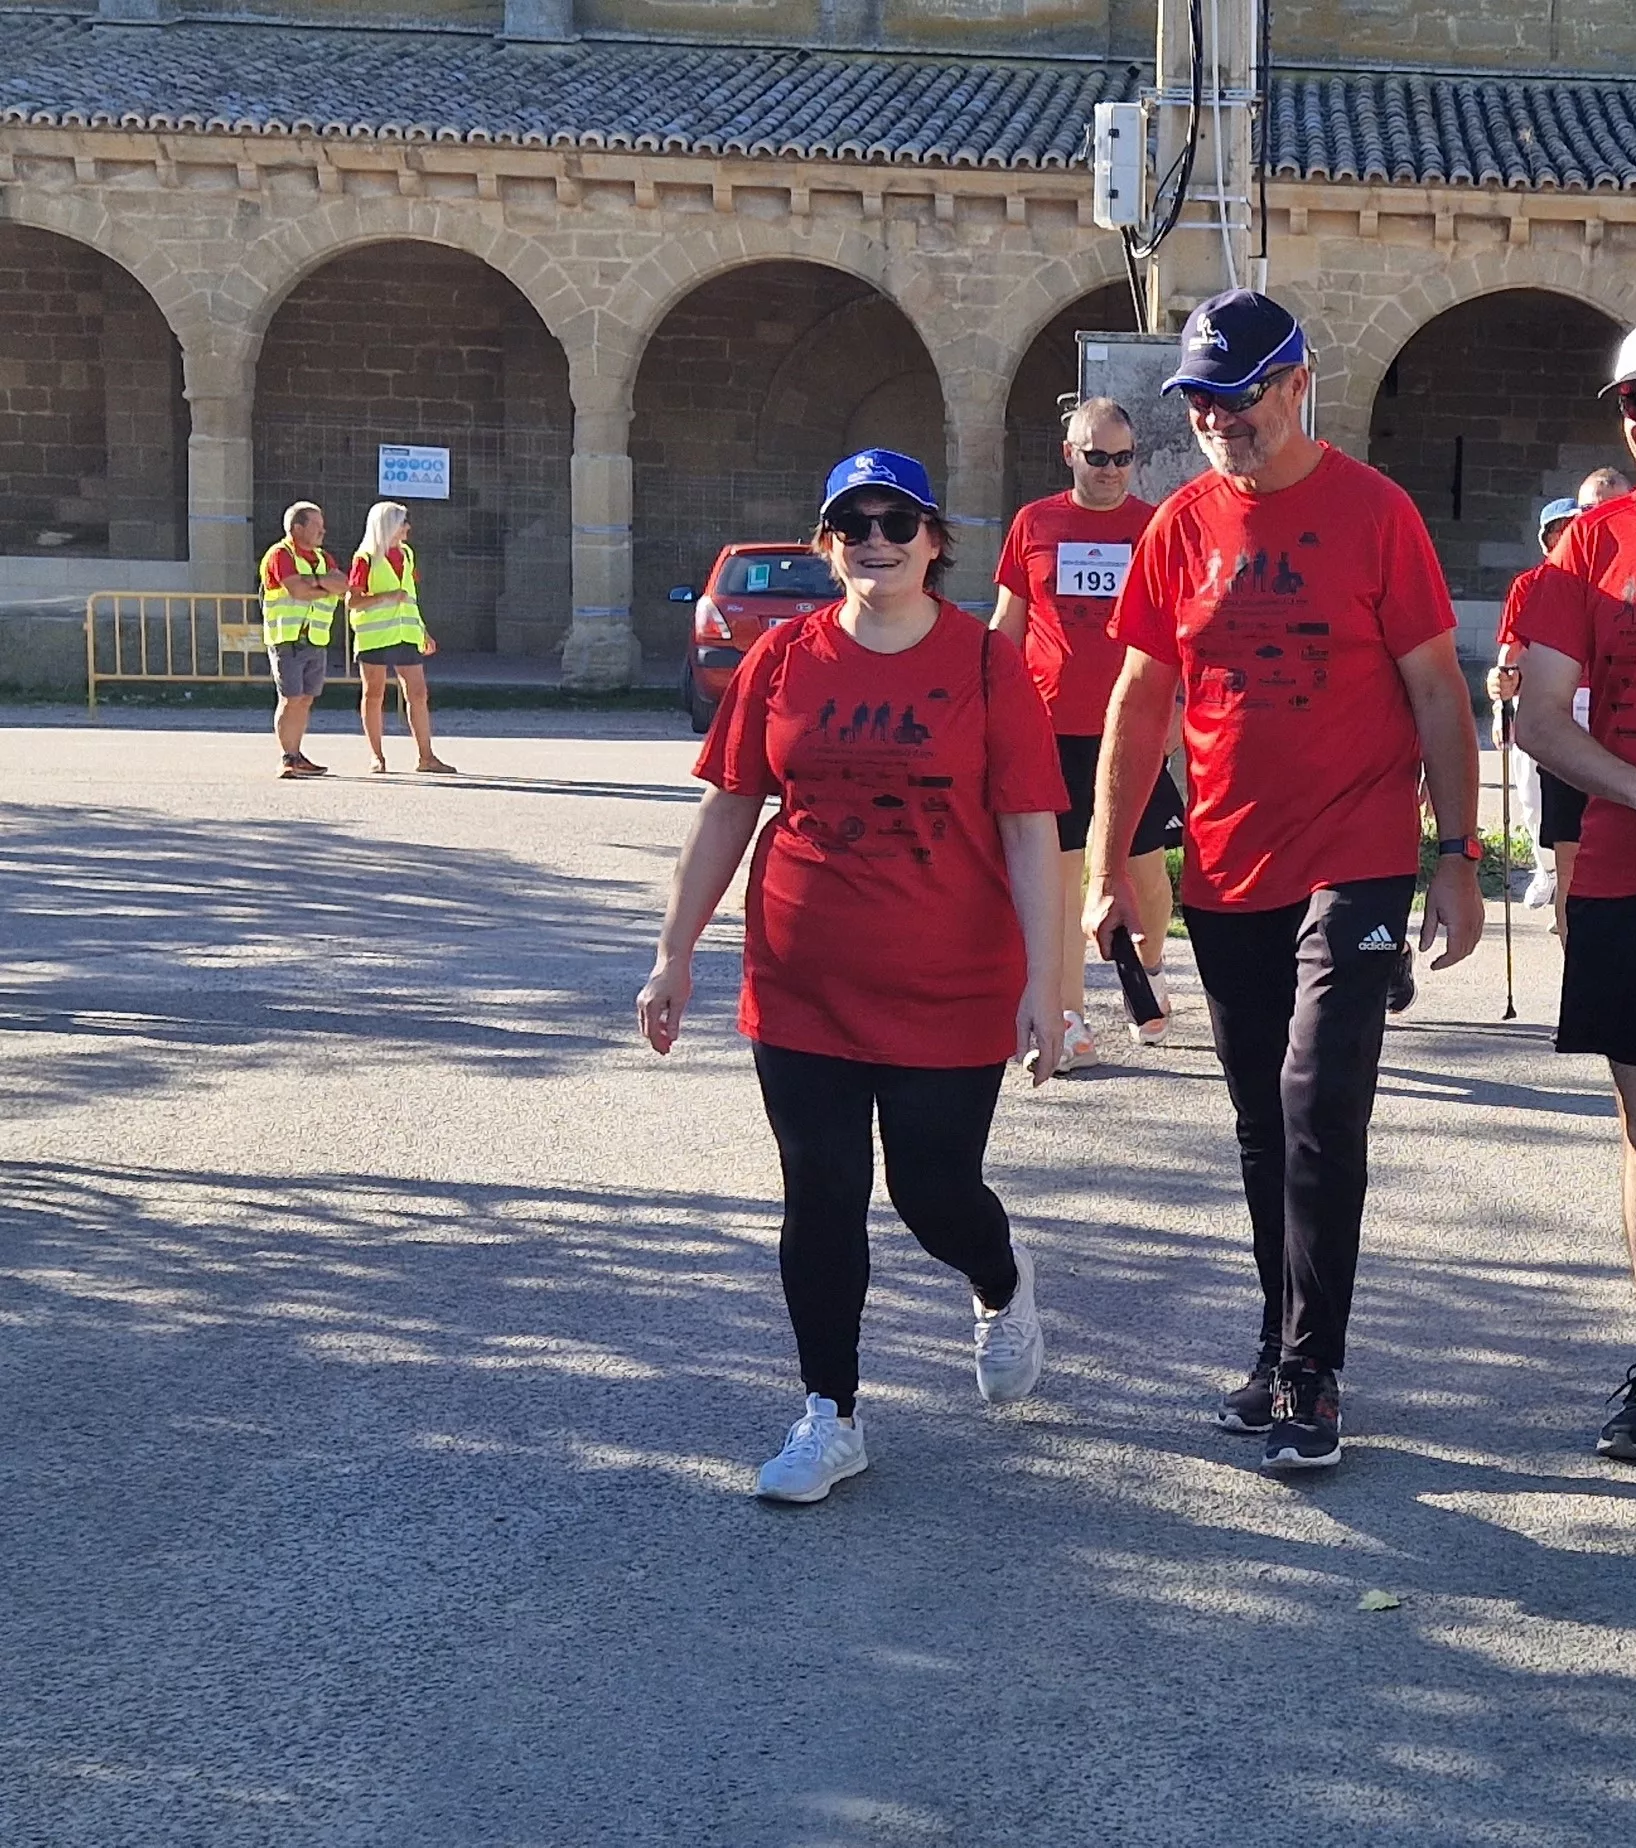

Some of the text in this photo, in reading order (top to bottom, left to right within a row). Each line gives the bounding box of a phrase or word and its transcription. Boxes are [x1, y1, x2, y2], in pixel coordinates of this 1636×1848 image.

[750, 567, 765, 585] L
[1073, 570, 1116, 592] 193
[1358, 941, 1398, 951] adidas
